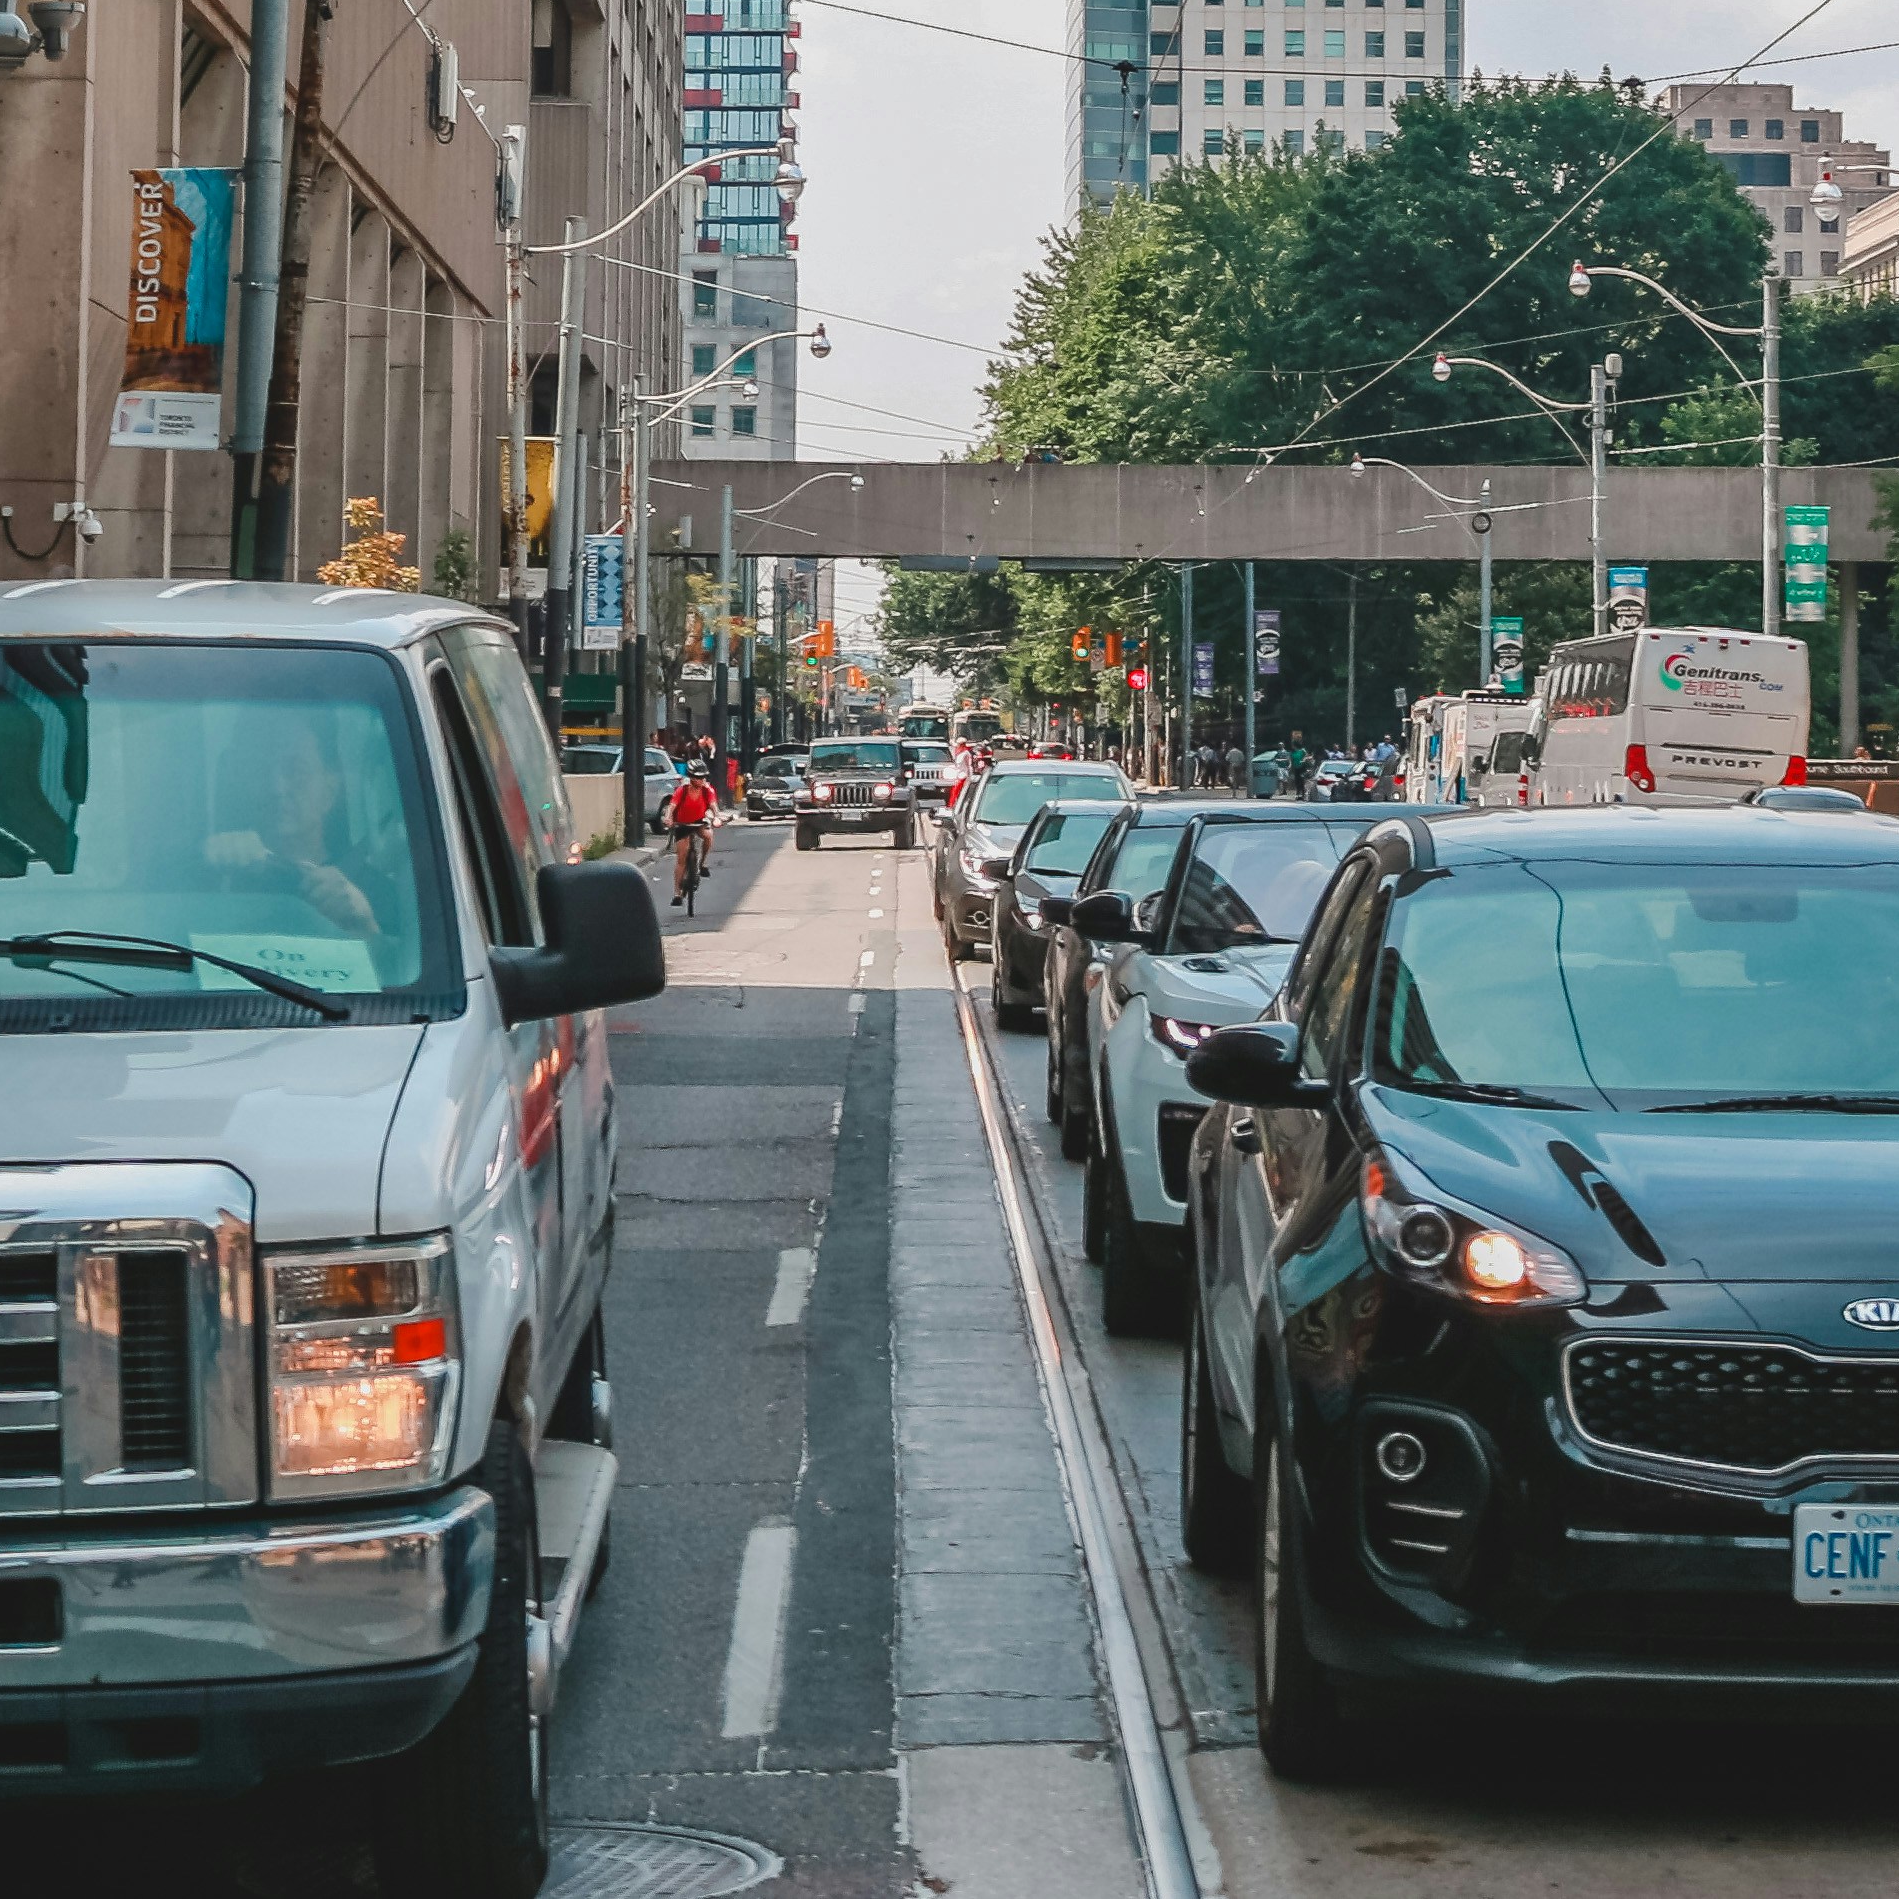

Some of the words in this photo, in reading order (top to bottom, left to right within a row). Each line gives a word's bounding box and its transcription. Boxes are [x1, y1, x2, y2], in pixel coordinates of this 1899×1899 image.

[135, 182, 164, 323] DISCOVER
[1671, 754, 1763, 769] PREVOST
[1805, 1531, 1893, 1579] CENF
